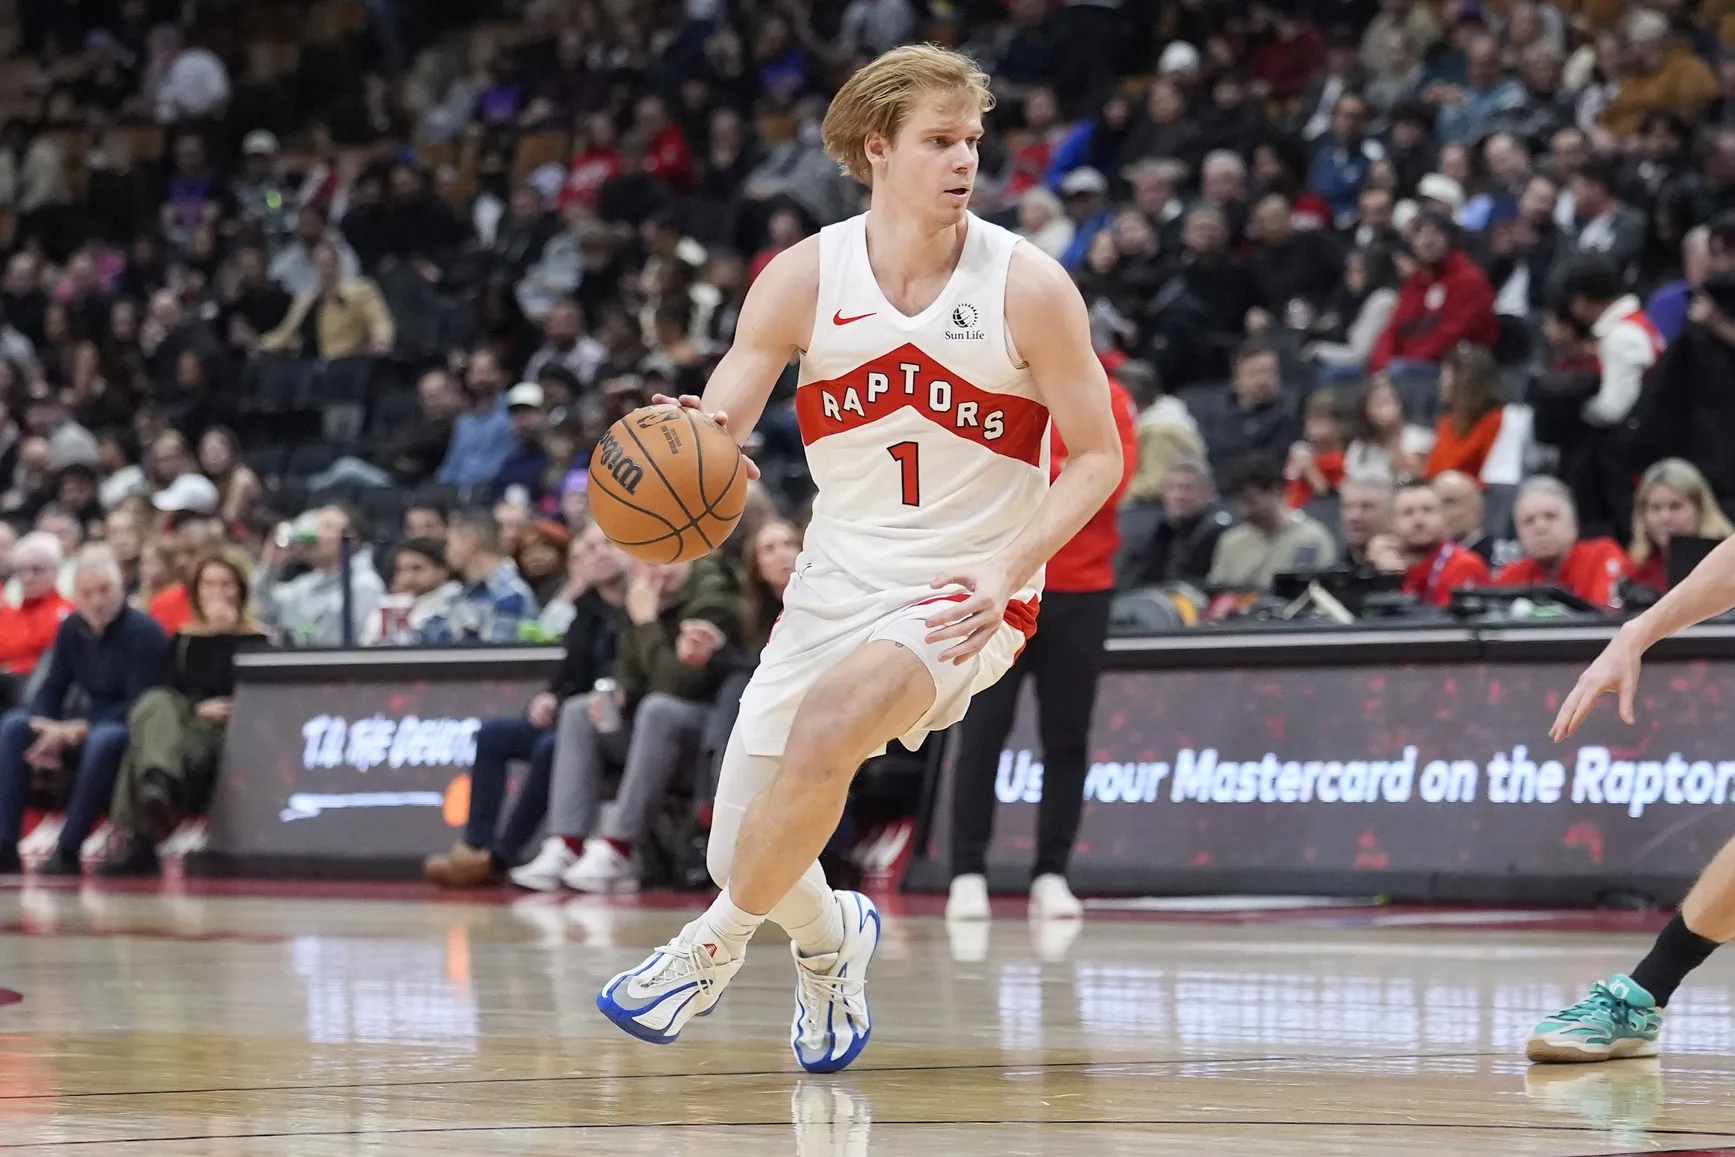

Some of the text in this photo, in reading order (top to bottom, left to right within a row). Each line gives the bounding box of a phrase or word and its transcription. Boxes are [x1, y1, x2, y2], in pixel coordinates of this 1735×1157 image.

[945, 330, 985, 340] Sun Life
[821, 361, 1005, 440] RAPTORS
[886, 440, 920, 507] 1
[995, 749, 1045, 803] Us
[1170, 747, 1419, 803] Mastercard
[1419, 760, 1479, 803] on
[1487, 744, 1565, 803] the
[1571, 746, 1735, 818] Raptor
